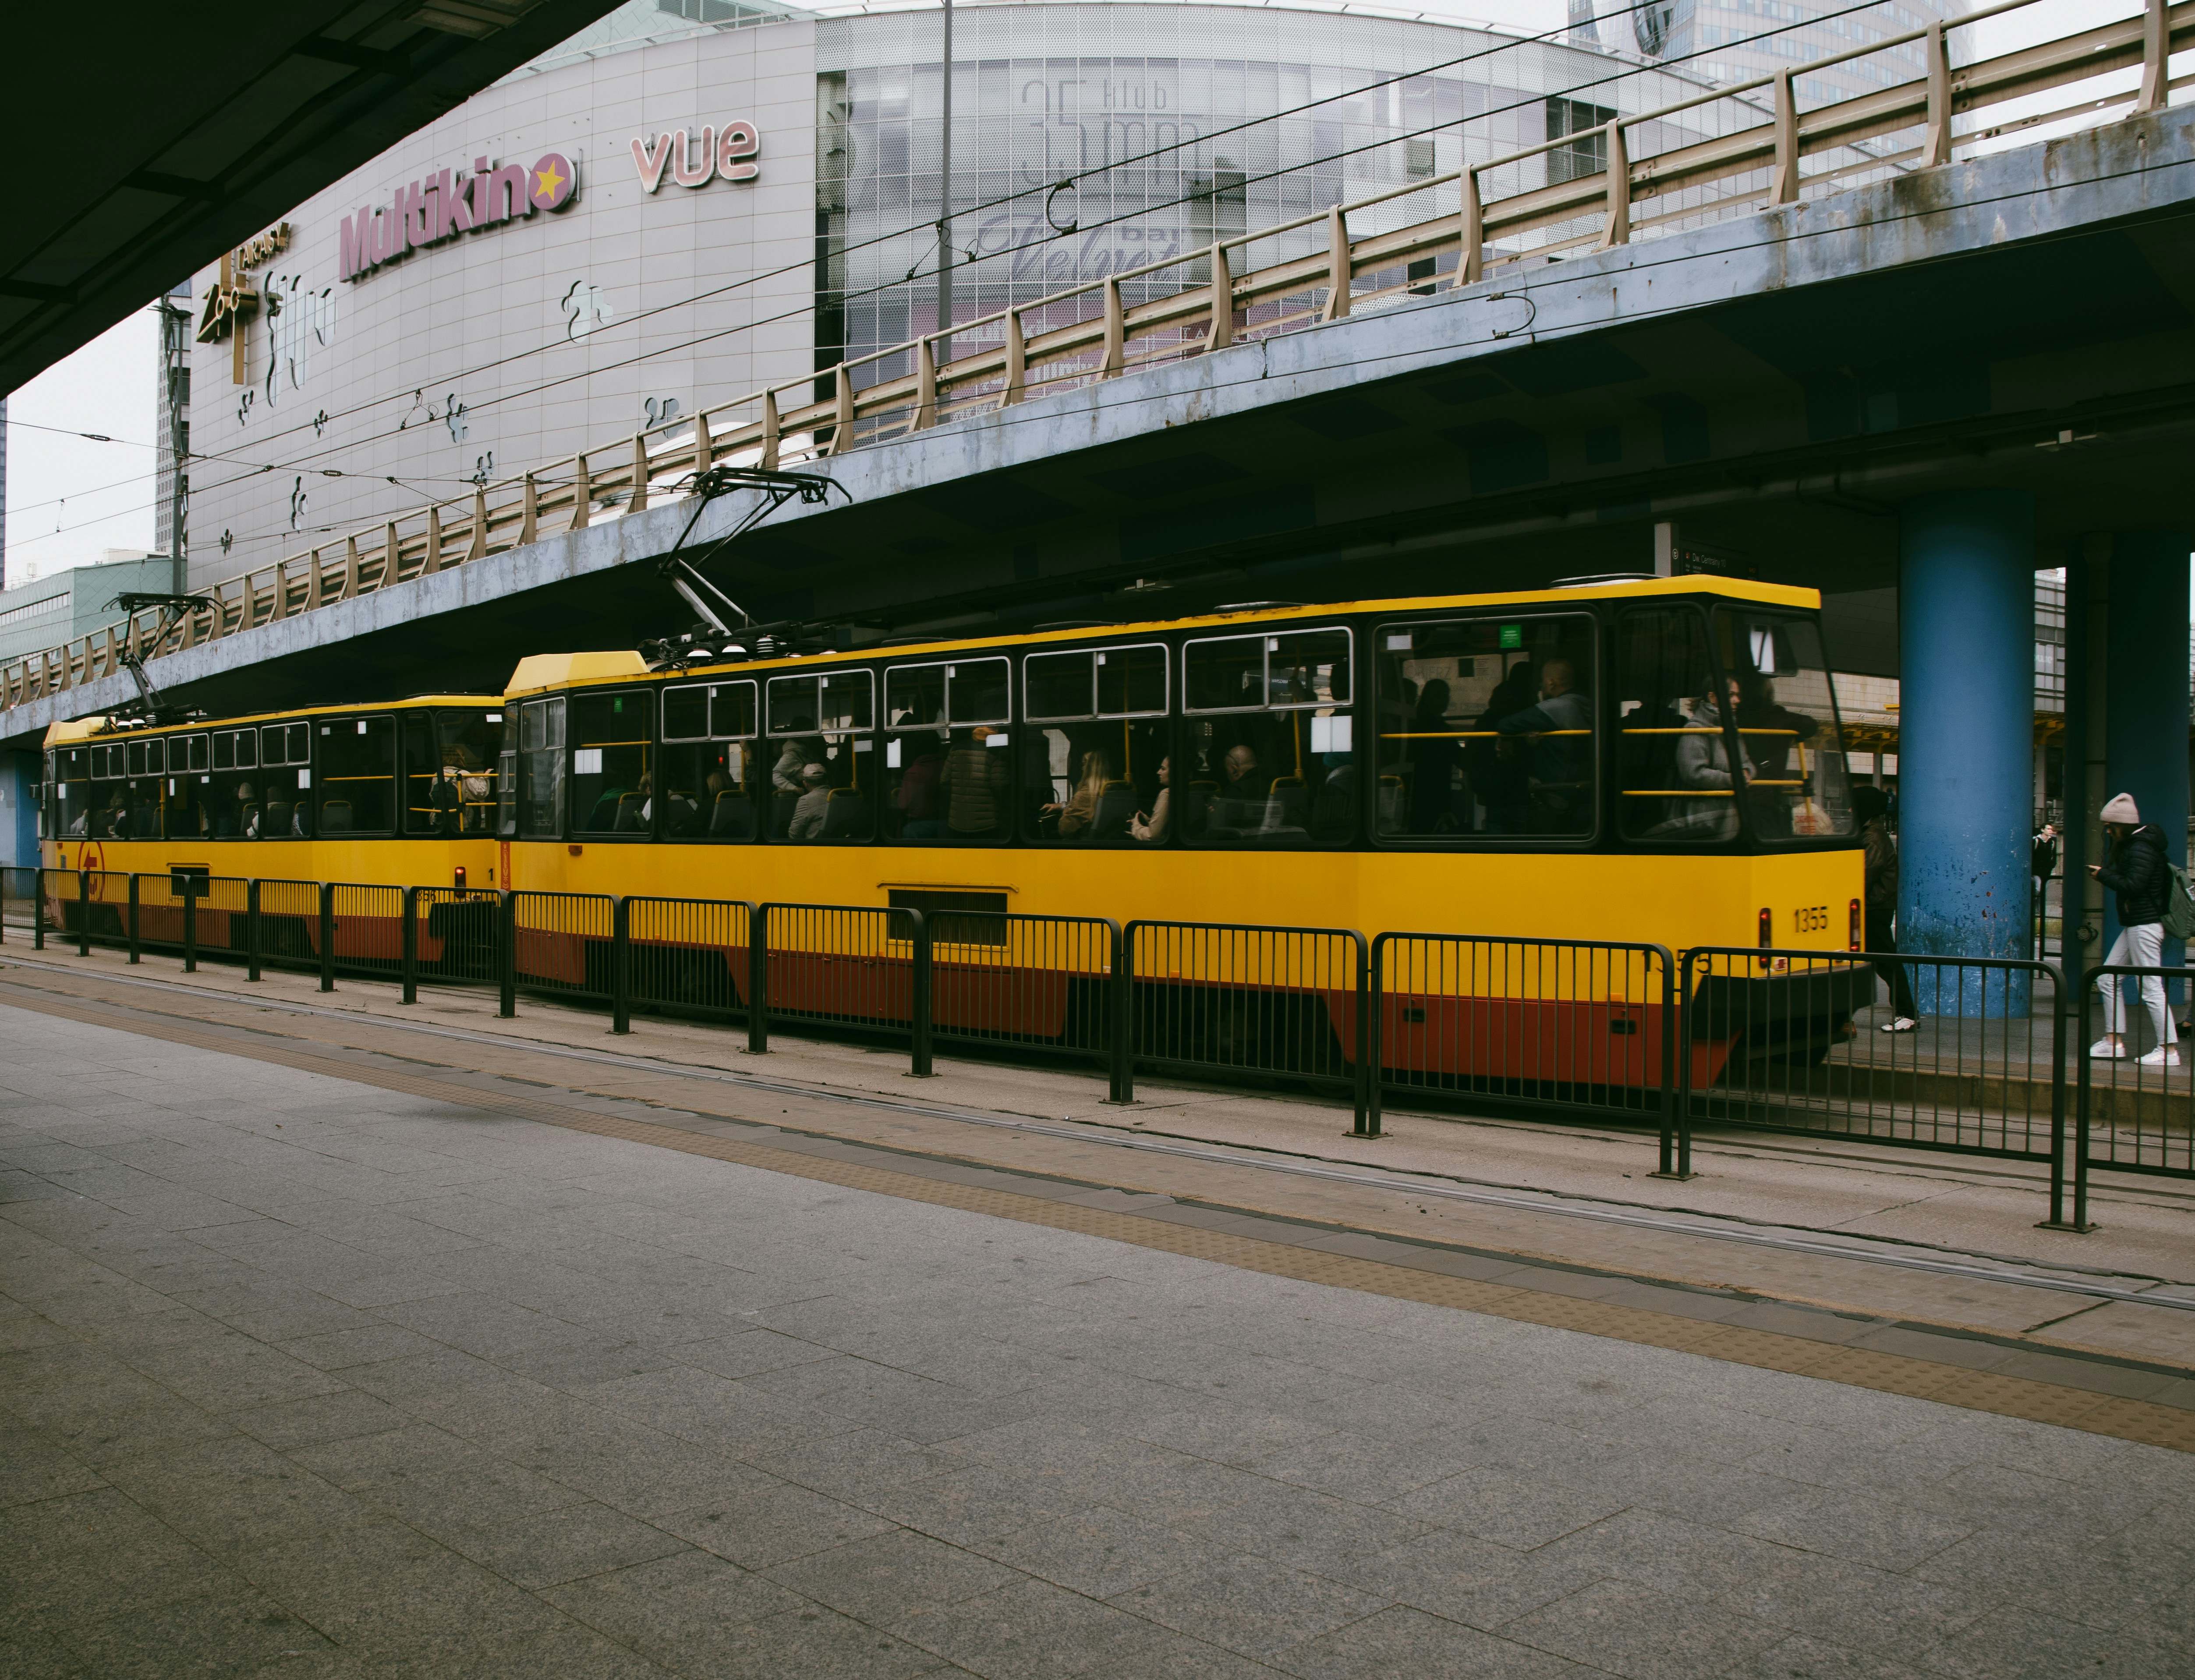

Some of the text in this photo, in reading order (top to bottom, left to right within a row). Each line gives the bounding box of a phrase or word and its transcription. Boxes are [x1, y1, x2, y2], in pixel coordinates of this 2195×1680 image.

[1103, 79, 1167, 110] klub
[629, 119, 759, 194] vue
[1020, 78, 1087, 185] 35
[236, 221, 290, 271] TARASY
[339, 152, 577, 283] Multikino
[1794, 906, 1827, 933] 1355
